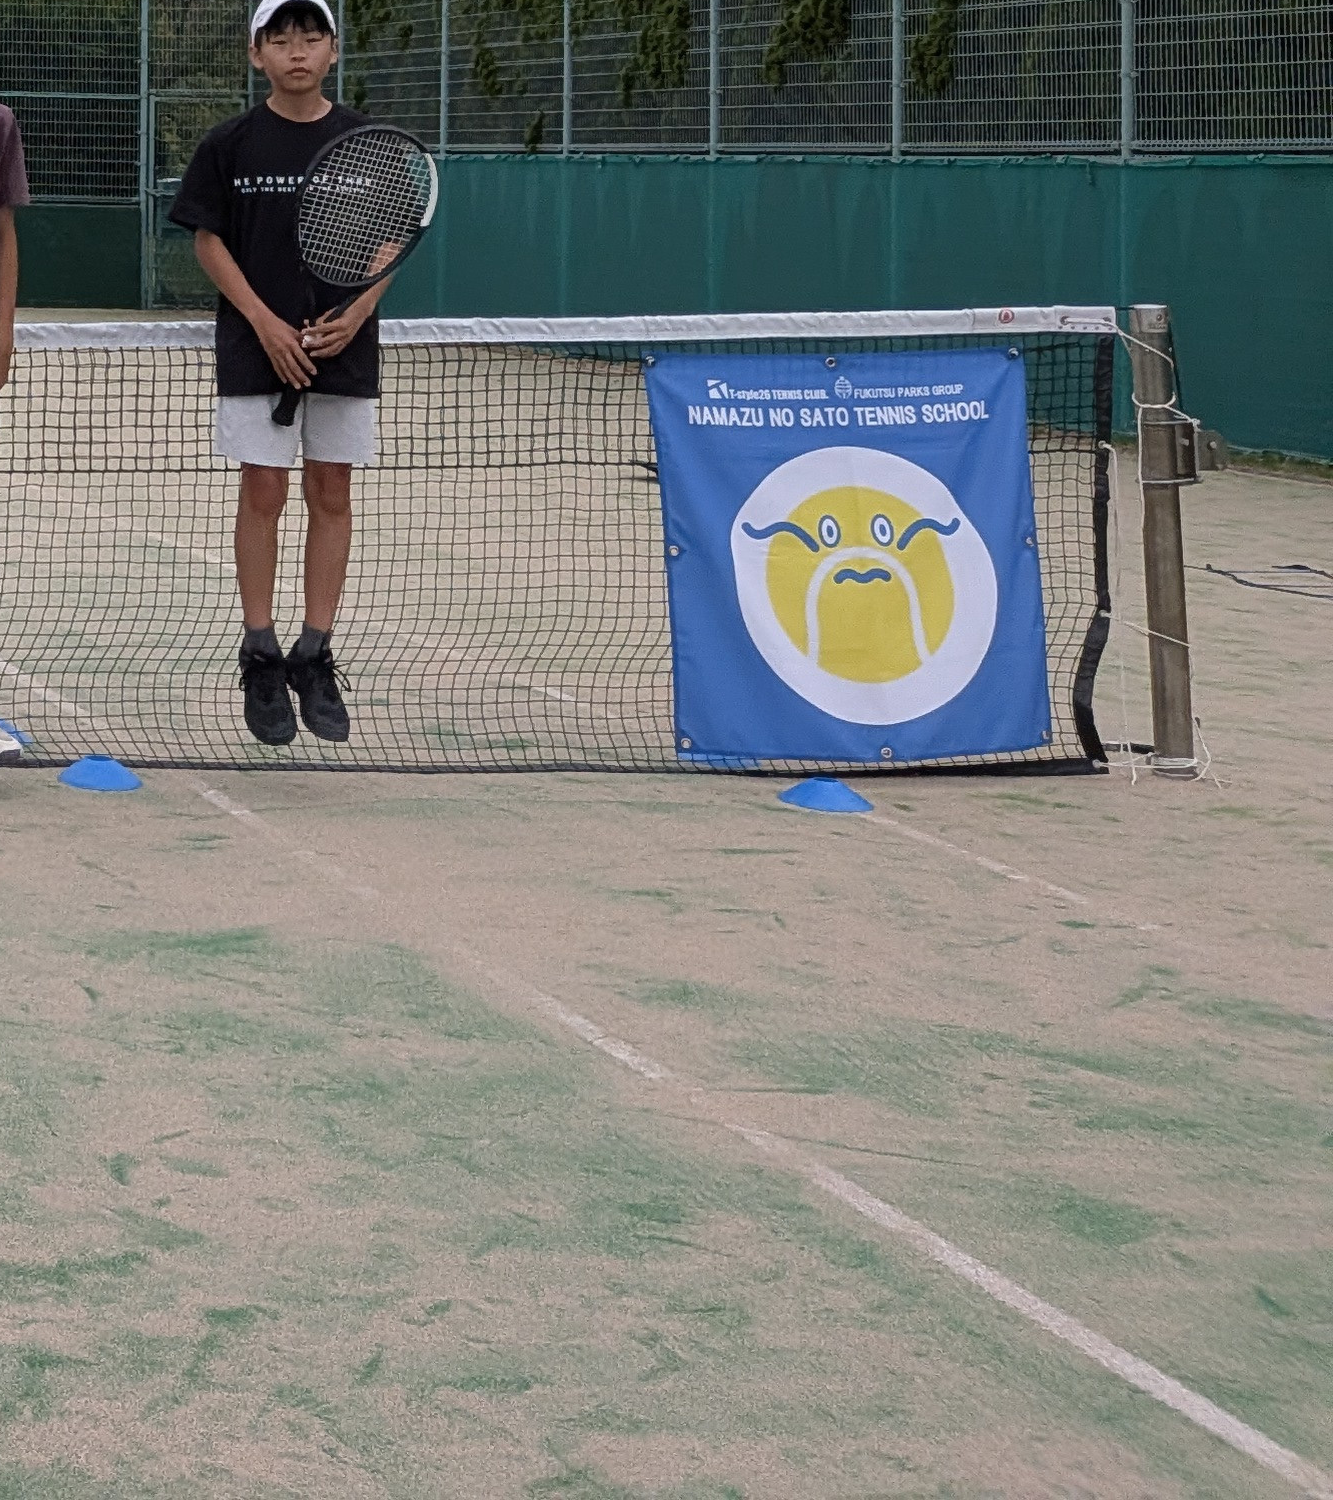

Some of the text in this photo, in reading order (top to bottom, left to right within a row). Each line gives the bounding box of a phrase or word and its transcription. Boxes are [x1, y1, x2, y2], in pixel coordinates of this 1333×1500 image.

[728, 388, 771, 401] T-style26
[771, 388, 803, 400] TENNIS
[854, 383, 964, 399] FUKUTSU PARKS GROUP
[687, 400, 990, 428] NAMAZU NO SATO TENNIS SCHOOL
